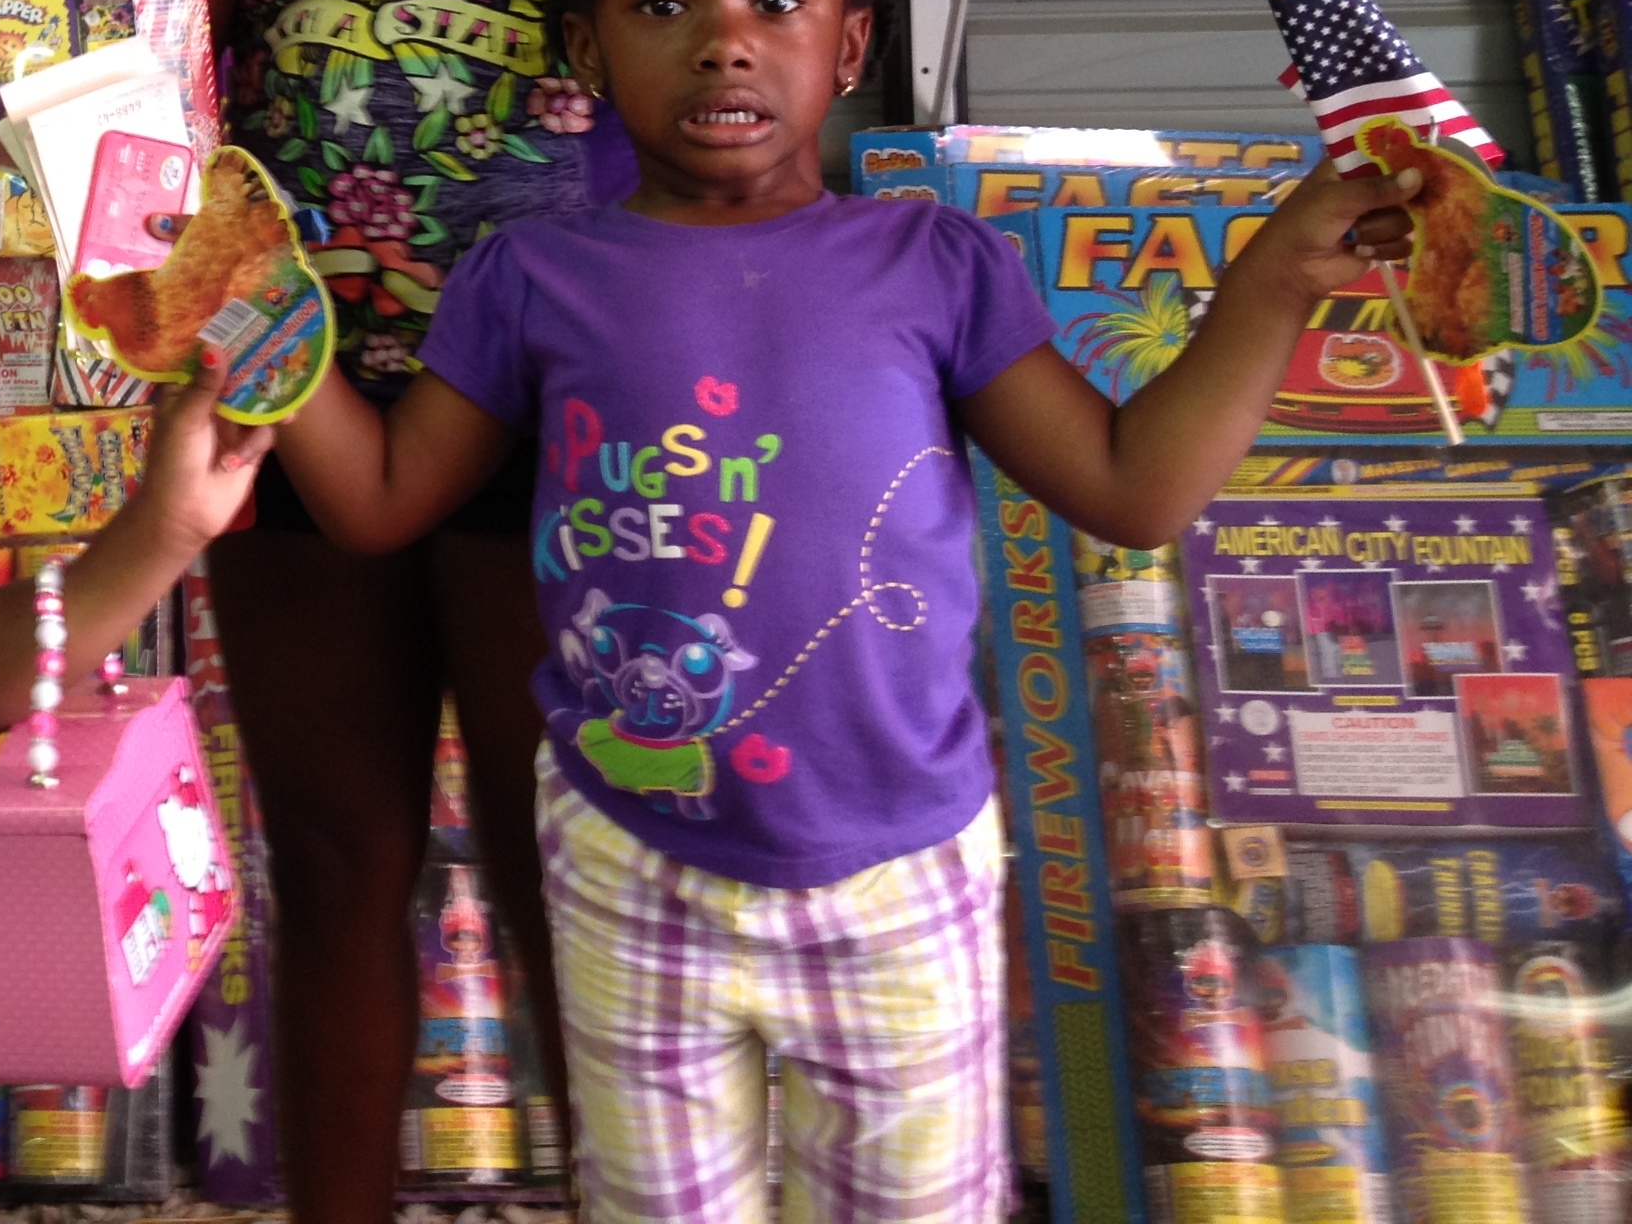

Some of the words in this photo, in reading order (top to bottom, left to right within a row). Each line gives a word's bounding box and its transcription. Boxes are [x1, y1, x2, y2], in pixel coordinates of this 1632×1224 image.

[0, 310, 49, 332] FTN
[562, 398, 713, 500] PUGS
[1214, 525, 1344, 557] AMERICAN
[1345, 531, 1411, 563] CITY
[1413, 535, 1532, 565] FOUNTAIN
[1332, 716, 1416, 731] CAUTION
[1002, 497, 1102, 993] FIREWORKS
